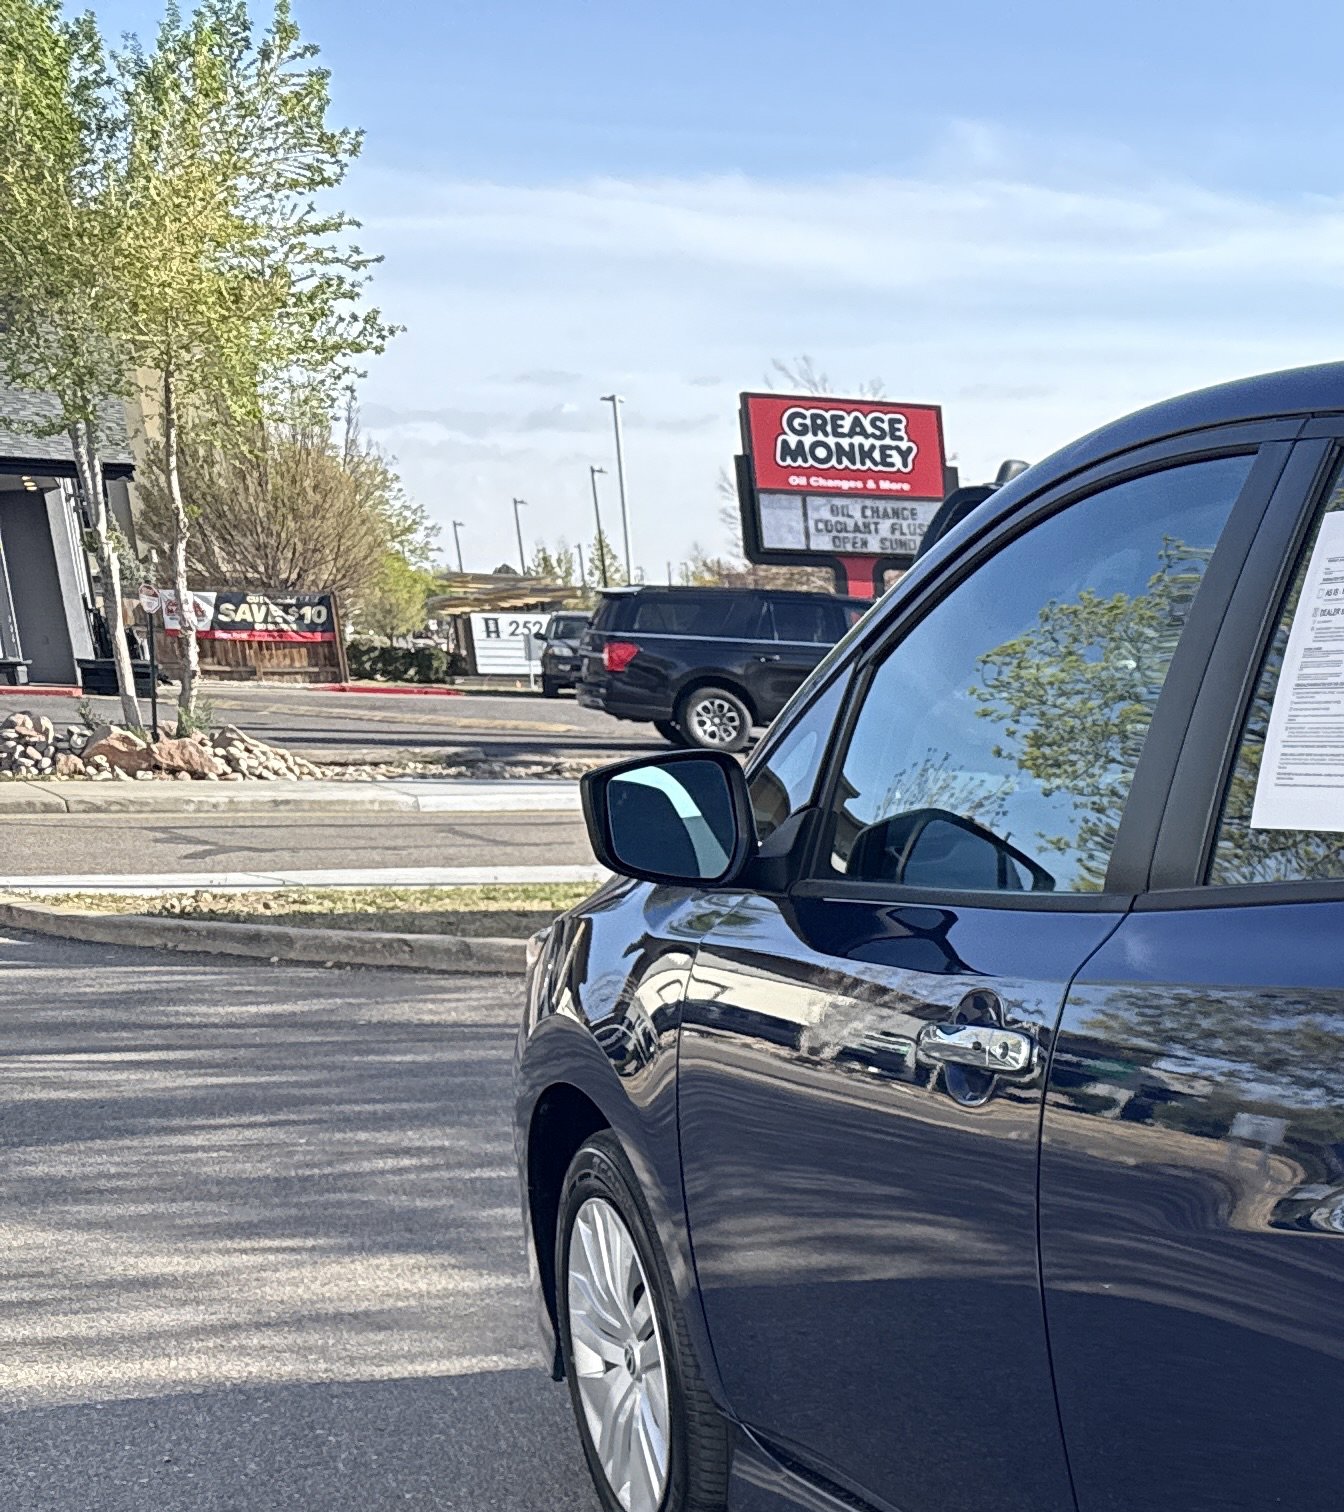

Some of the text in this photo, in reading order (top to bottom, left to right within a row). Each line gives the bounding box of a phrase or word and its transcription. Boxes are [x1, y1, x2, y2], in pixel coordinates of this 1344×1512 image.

[785, 410, 905, 442] GREASE
[778, 438, 914, 470] MONKEY
[788, 476, 911, 491] Oil Changes & More
[829, 503, 918, 521] OIL CHANGE
[814, 519, 880, 536] COOLANT
[831, 535, 869, 550] OPEN
[288, 604, 327, 625] $10
